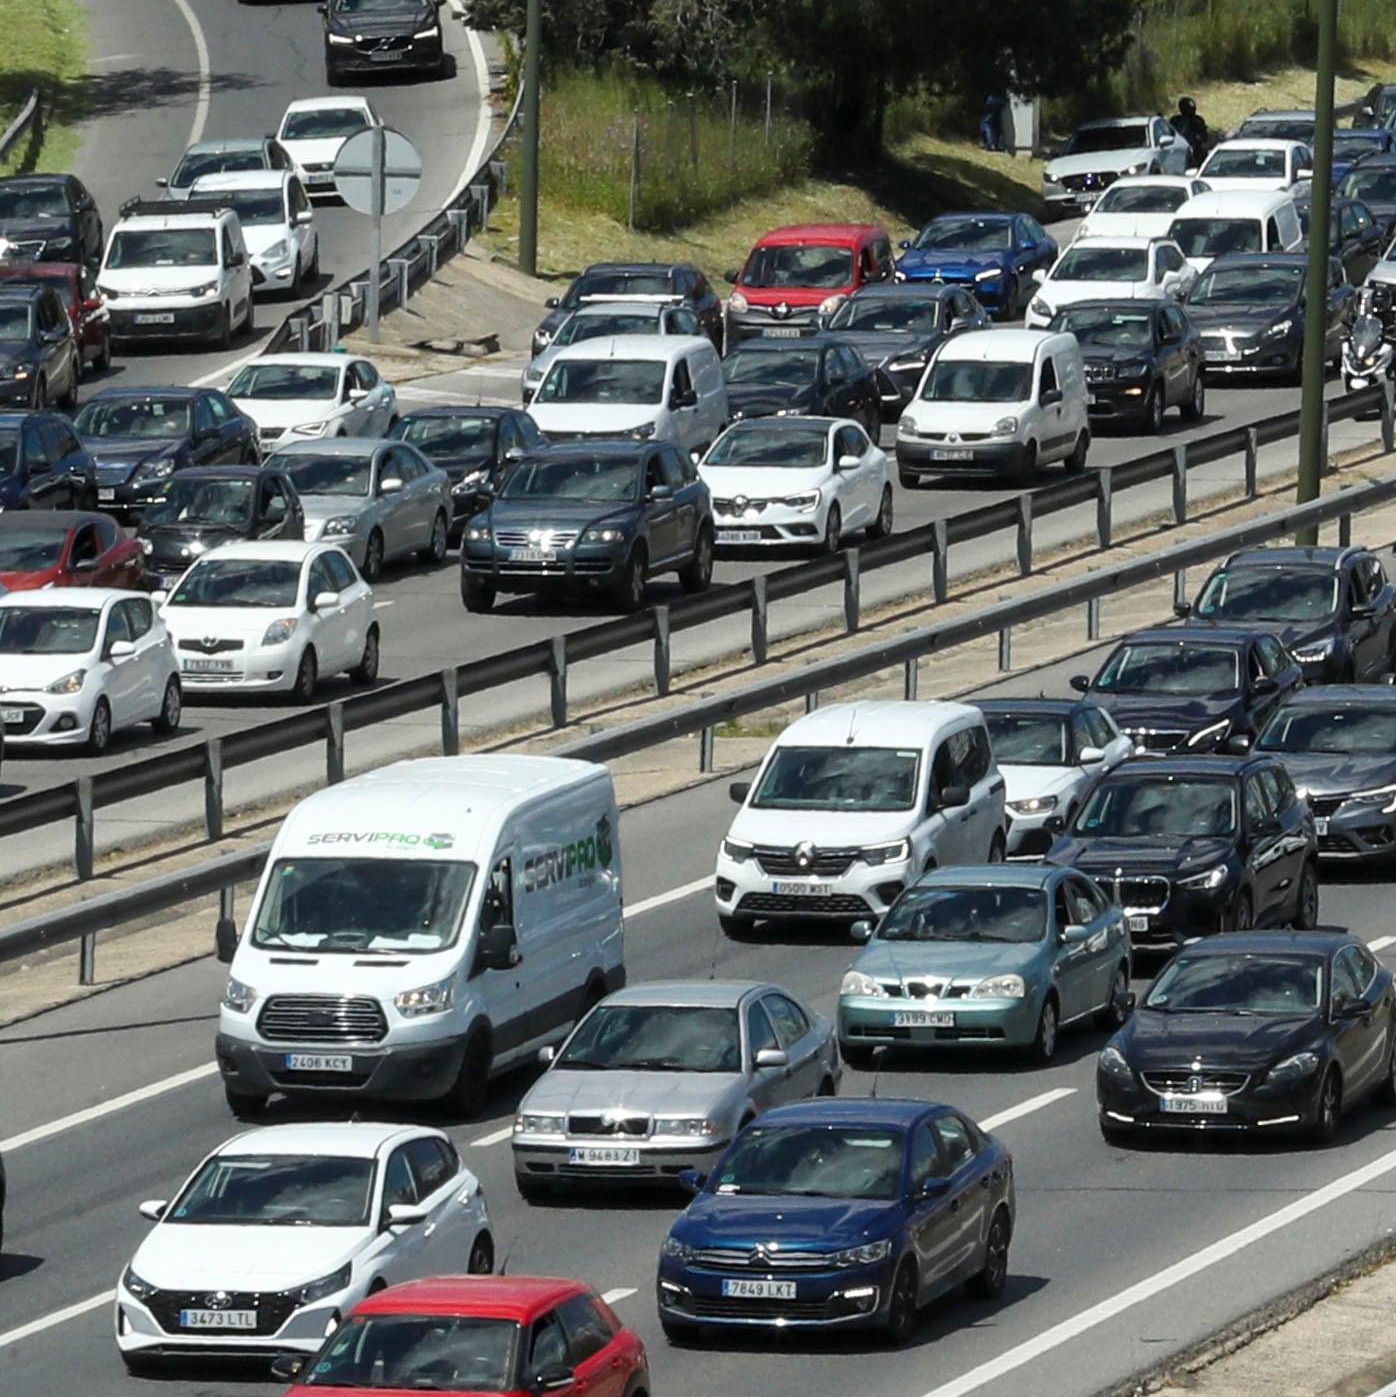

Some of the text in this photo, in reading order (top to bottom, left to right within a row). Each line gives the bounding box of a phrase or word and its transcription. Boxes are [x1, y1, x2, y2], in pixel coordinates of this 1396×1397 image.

[779, 882, 808, 894] 0500
[292, 1055, 349, 1069] 2406 KCY
[731, 1281, 793, 1296] 7849 LKT
[190, 1311, 254, 1326] 3473 LTL
